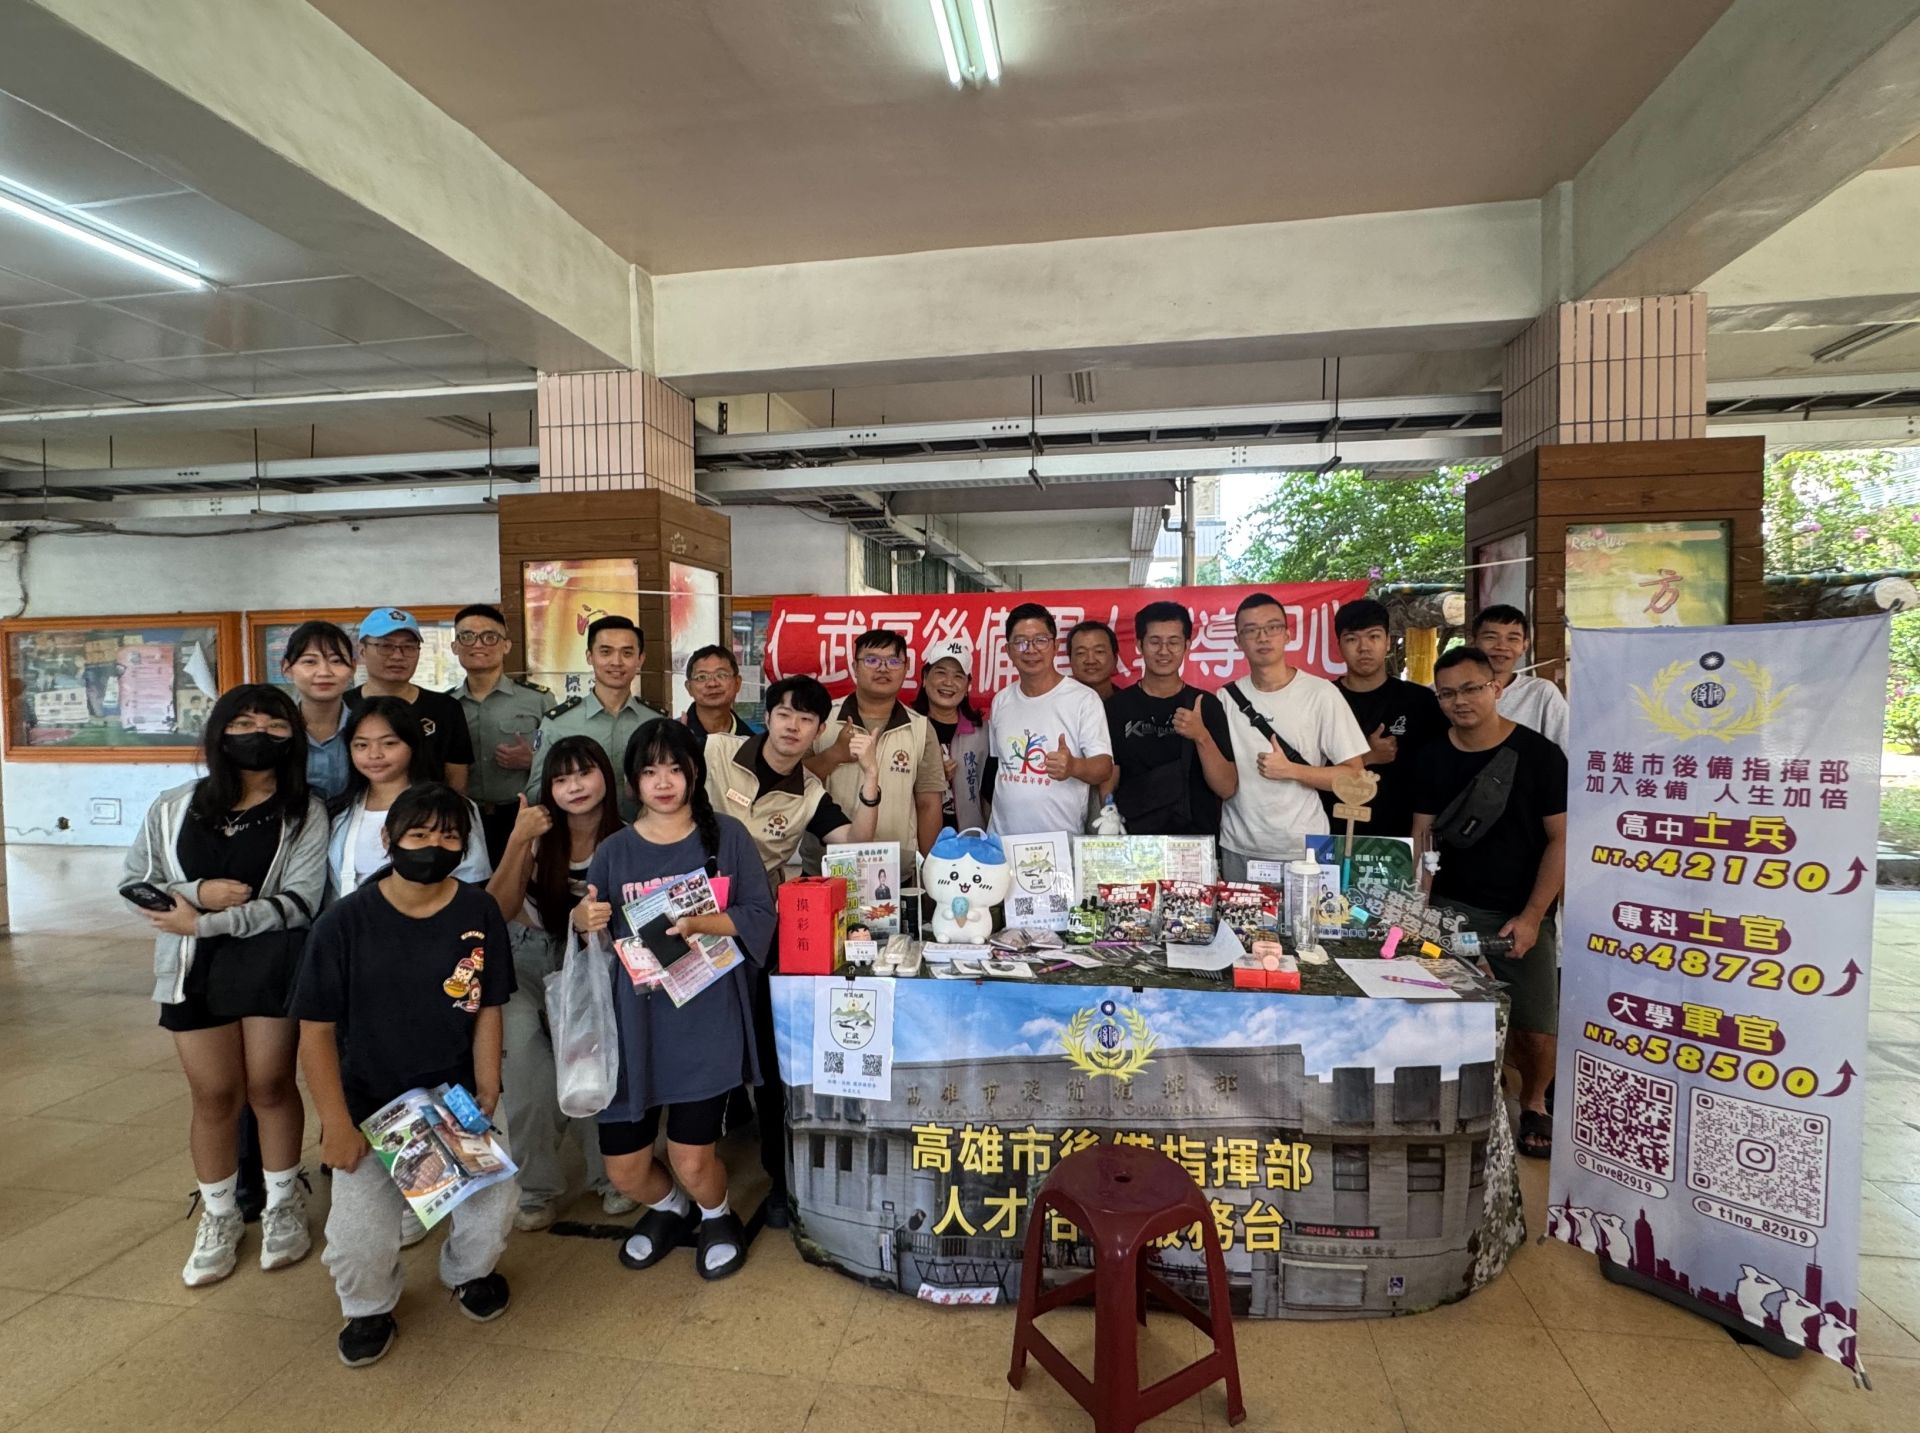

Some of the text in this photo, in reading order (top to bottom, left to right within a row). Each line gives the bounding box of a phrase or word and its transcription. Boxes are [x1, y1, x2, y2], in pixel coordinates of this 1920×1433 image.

[1587, 750, 1850, 785] 高雄市後備指揮部
[1586, 775, 1849, 810] 加入後備 人生加倍
[1622, 812, 1787, 851] 高中士兵
[796, 897, 810, 952] 摸彩箱
[1617, 908, 1785, 952] 專科士官
[1613, 996, 1779, 1052] 大學軍官
[1591, 1158, 1653, 1193] love82919
[1718, 1206, 1809, 1243] ting_82919
